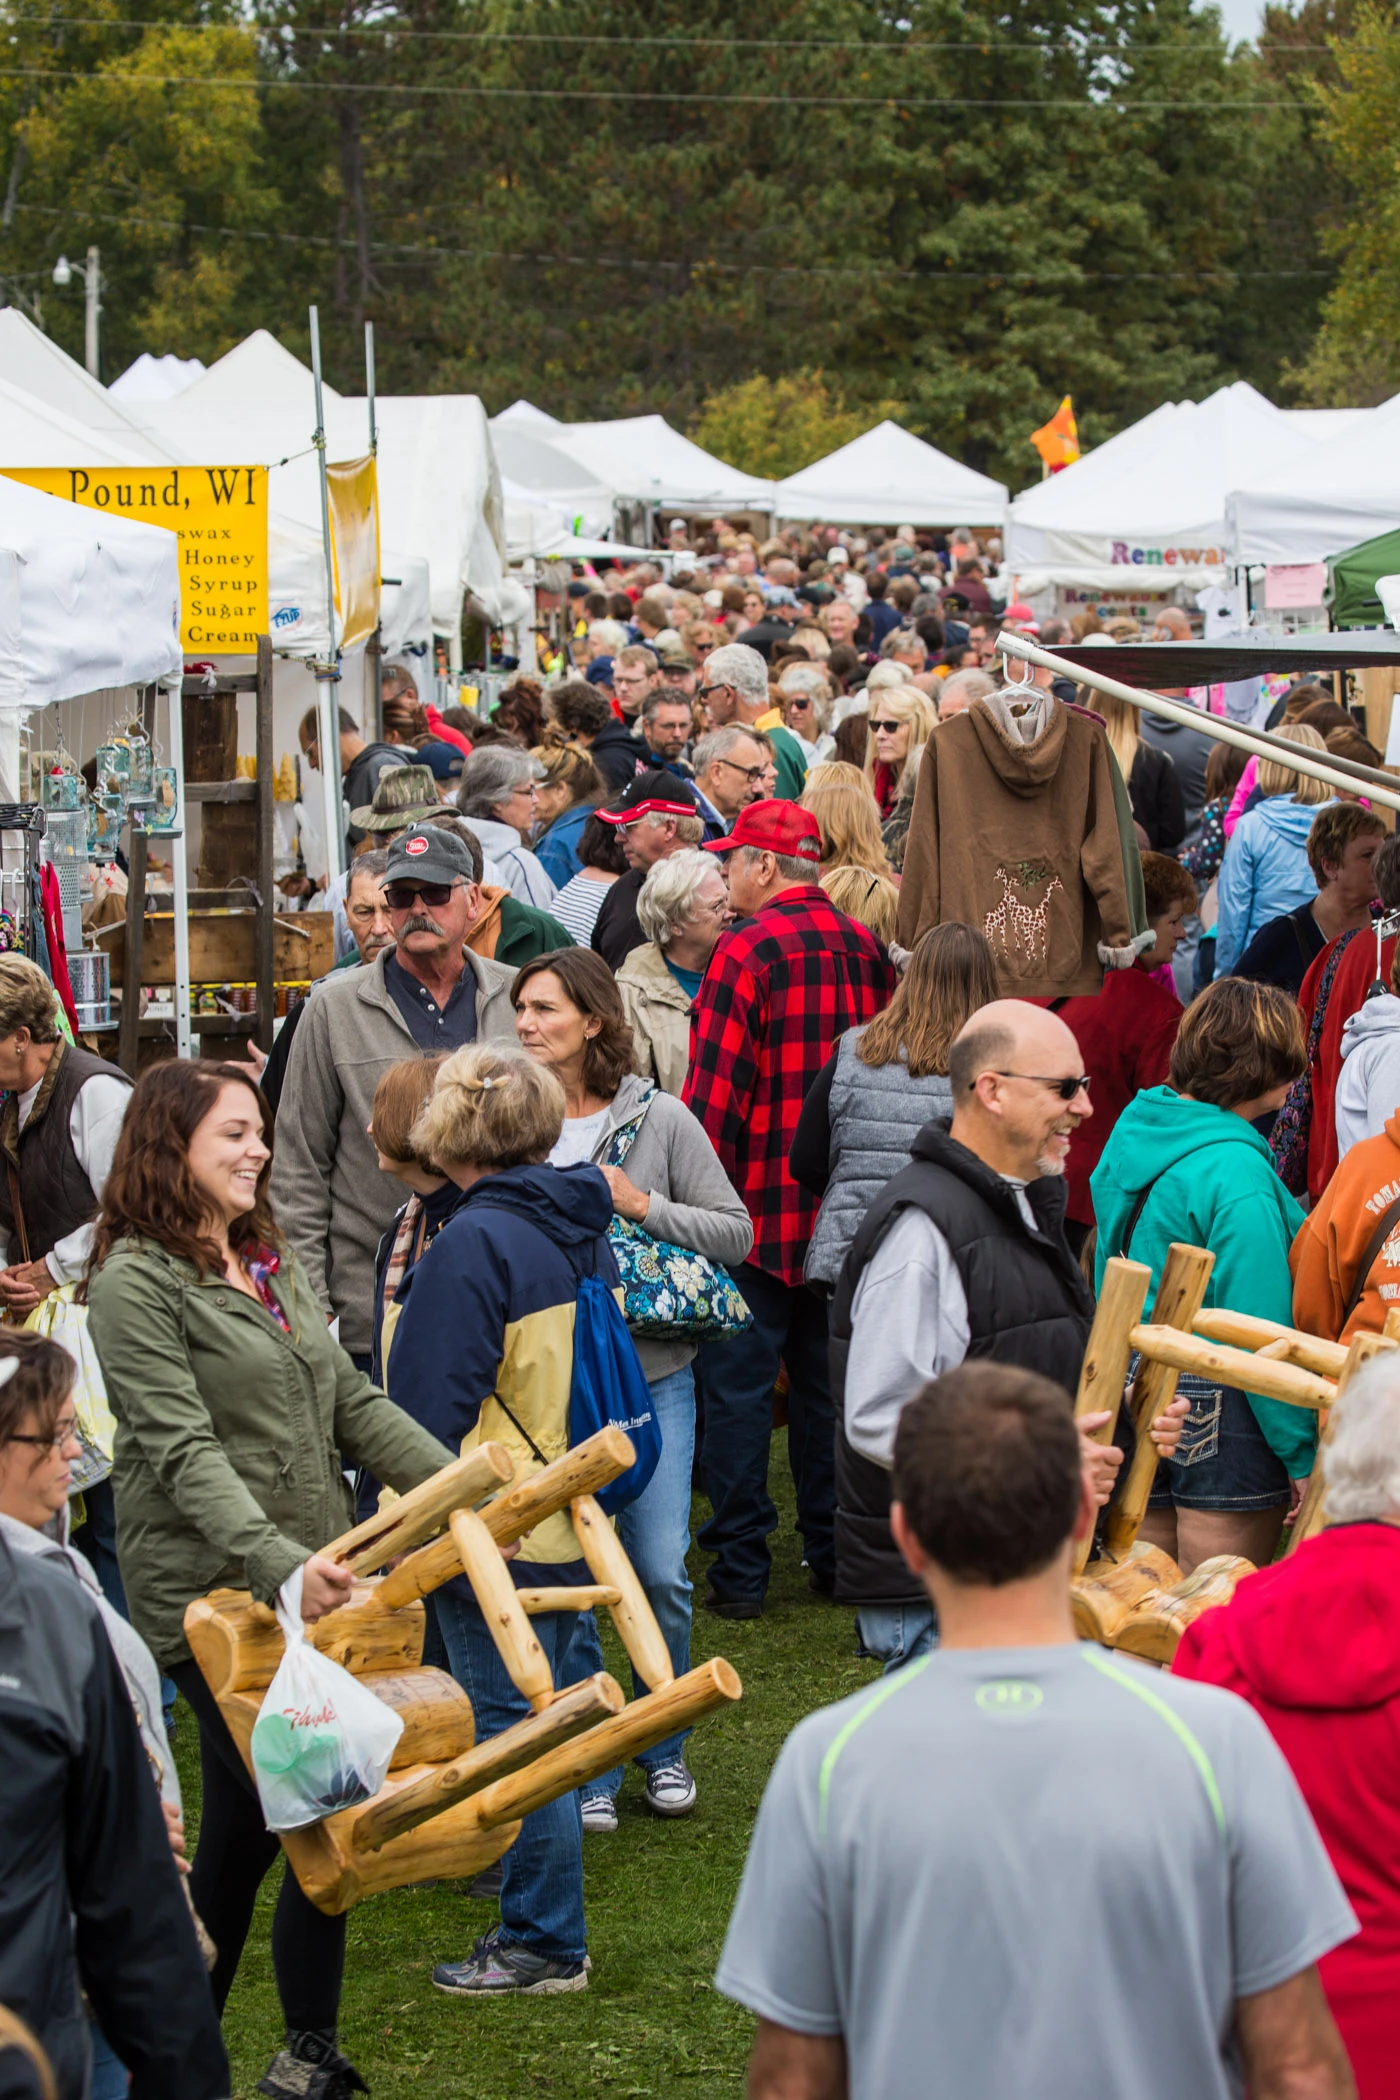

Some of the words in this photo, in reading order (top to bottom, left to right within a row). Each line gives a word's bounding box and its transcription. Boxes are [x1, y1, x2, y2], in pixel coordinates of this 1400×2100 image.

[69, 470, 190, 509] Pound,
[205, 468, 256, 505] WI
[177, 527, 232, 539] swax
[185, 549, 255, 568] Honey
[189, 575, 258, 594] Syrup
[191, 601, 257, 619] Sugar
[188, 626, 258, 643] Cream
[1365, 1177, 1400, 1215] TOMA
